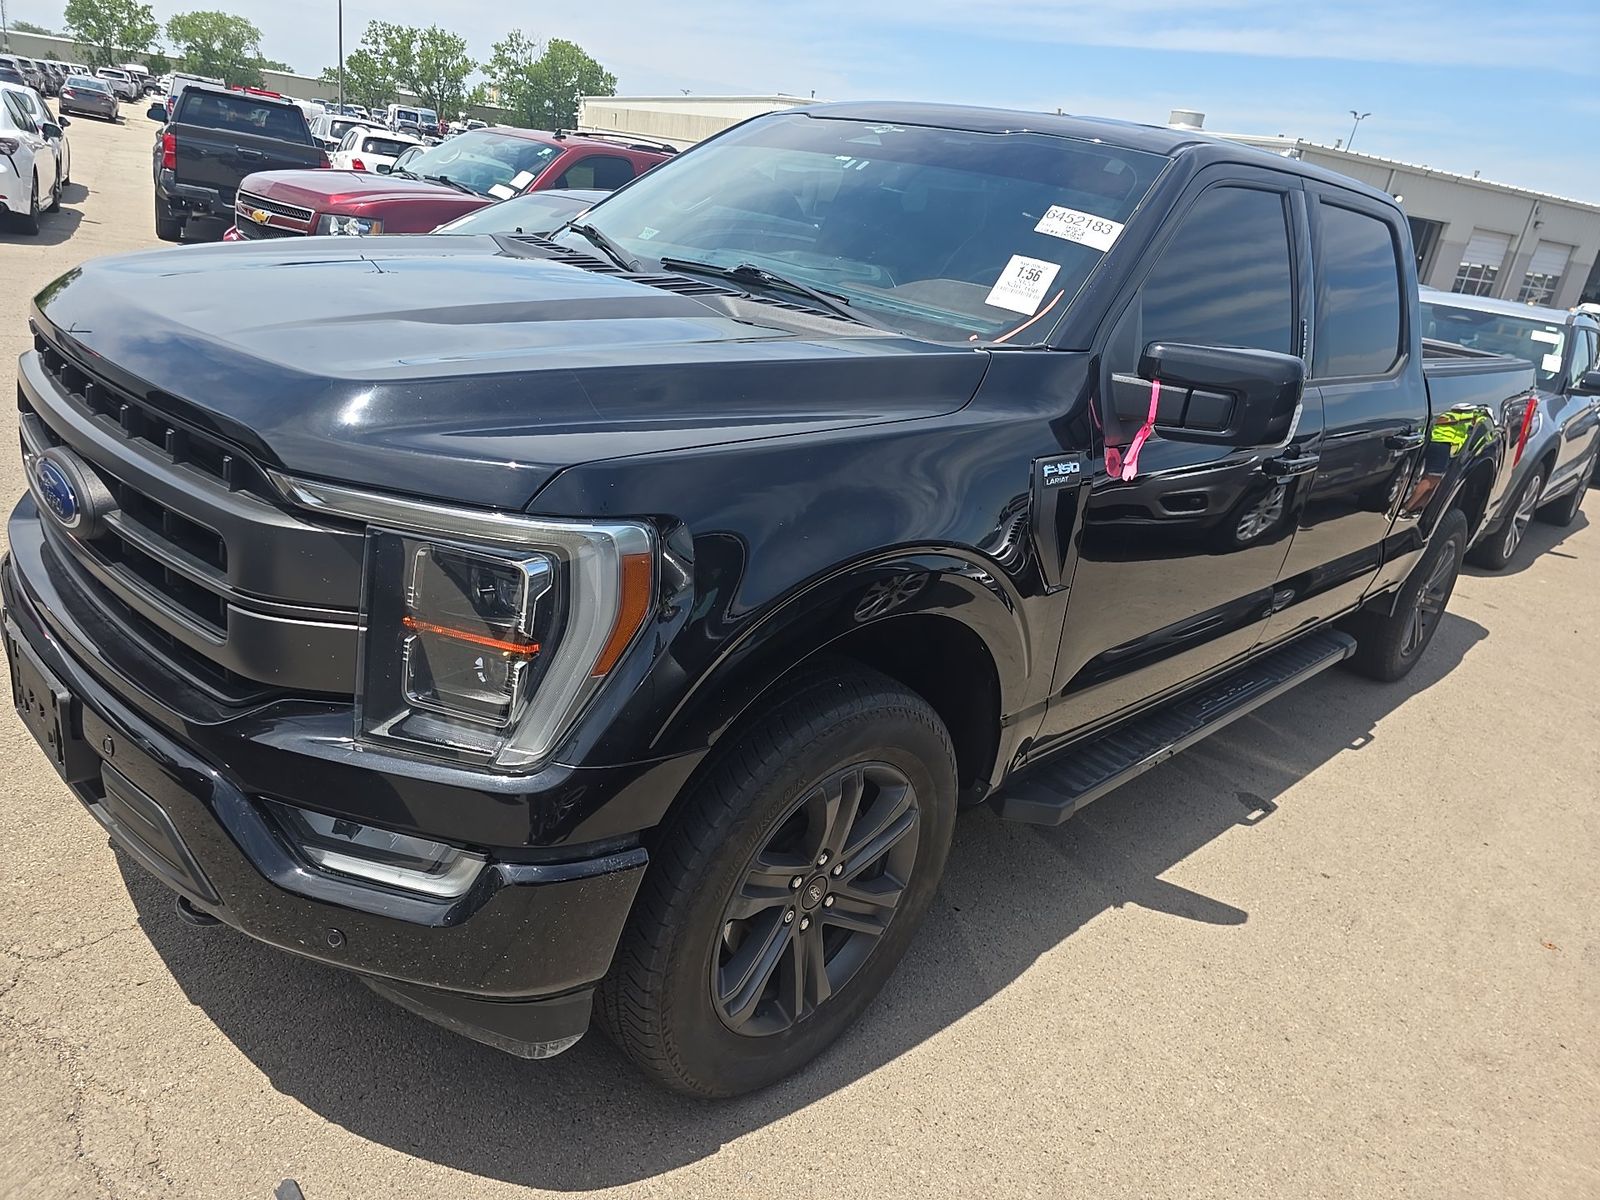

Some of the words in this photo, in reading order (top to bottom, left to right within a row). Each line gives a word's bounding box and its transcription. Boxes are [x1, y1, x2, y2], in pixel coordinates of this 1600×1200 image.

[1045, 209, 1113, 235] 6452183
[1016, 266, 1043, 282] 1:56
[1046, 476, 1069, 486] LARIAT
